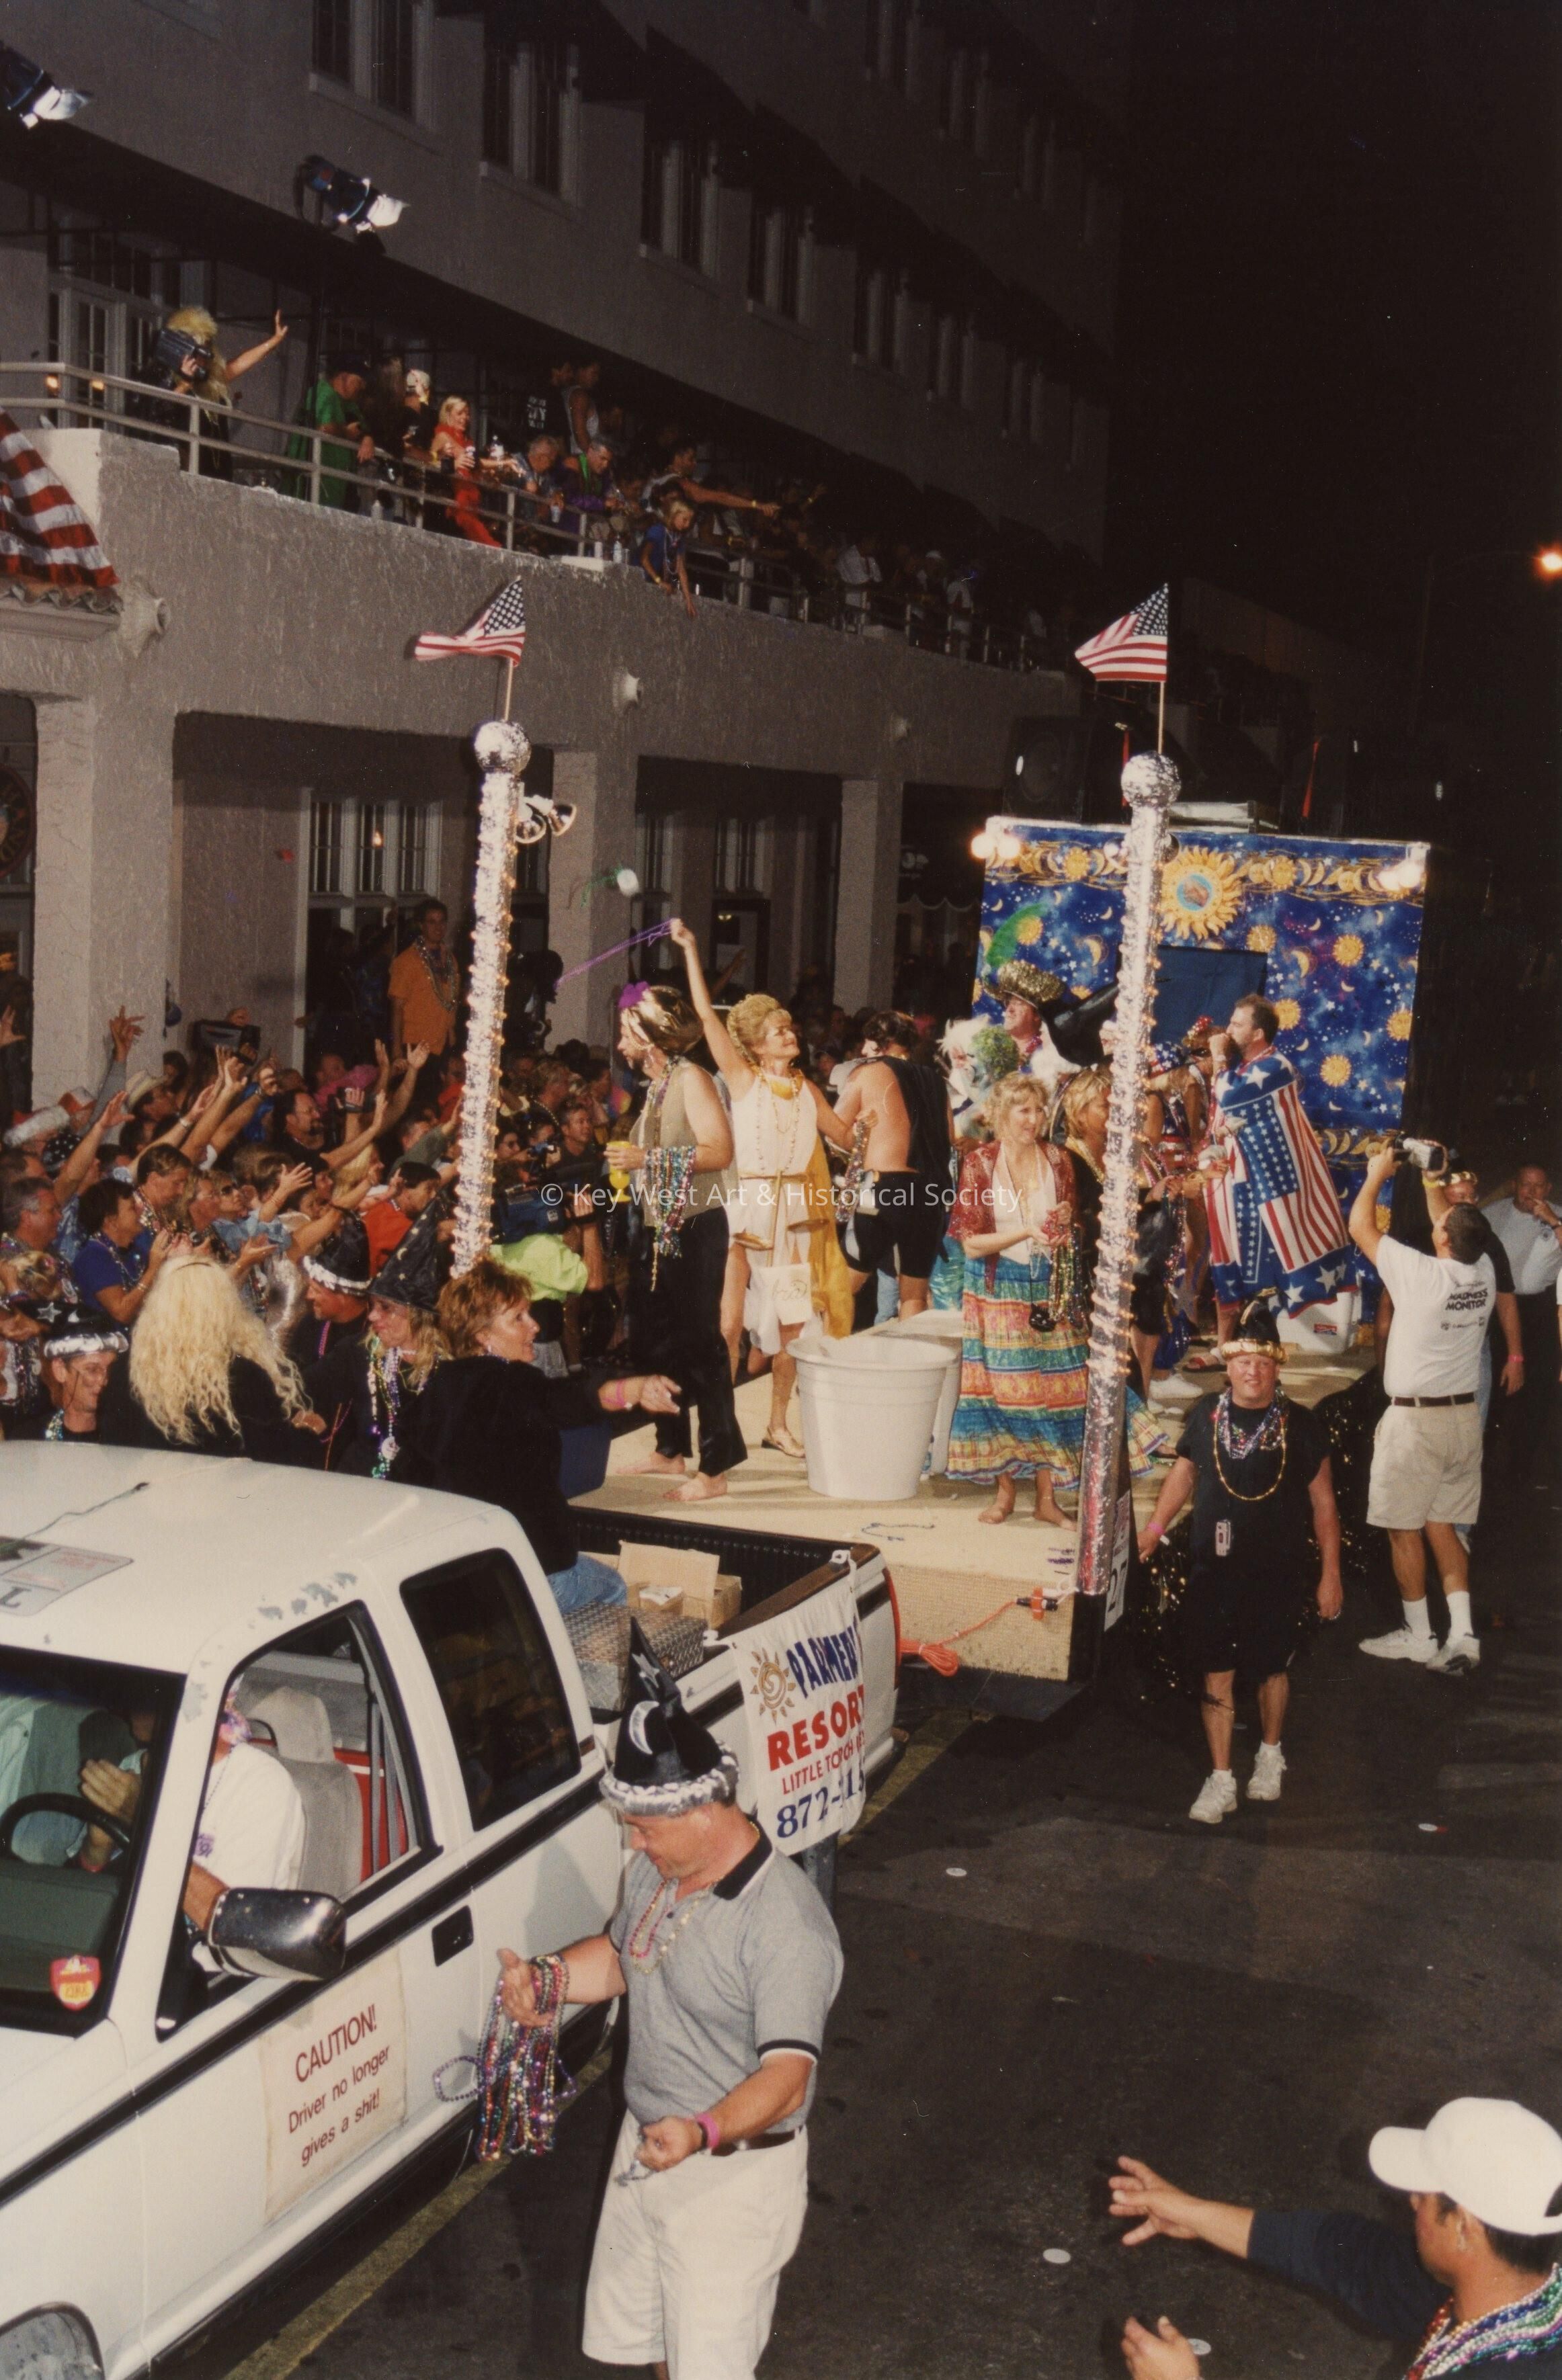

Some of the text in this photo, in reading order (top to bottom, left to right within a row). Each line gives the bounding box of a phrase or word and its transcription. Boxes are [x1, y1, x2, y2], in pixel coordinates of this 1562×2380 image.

[1445, 1298, 1486, 1311] MONITOR
[782, 1760, 823, 1795] LITTLE
[296, 2003, 377, 2082] CAUTION!
[289, 2045, 390, 2134] Driver no longer
[301, 2088, 380, 2167] gives a shit!
